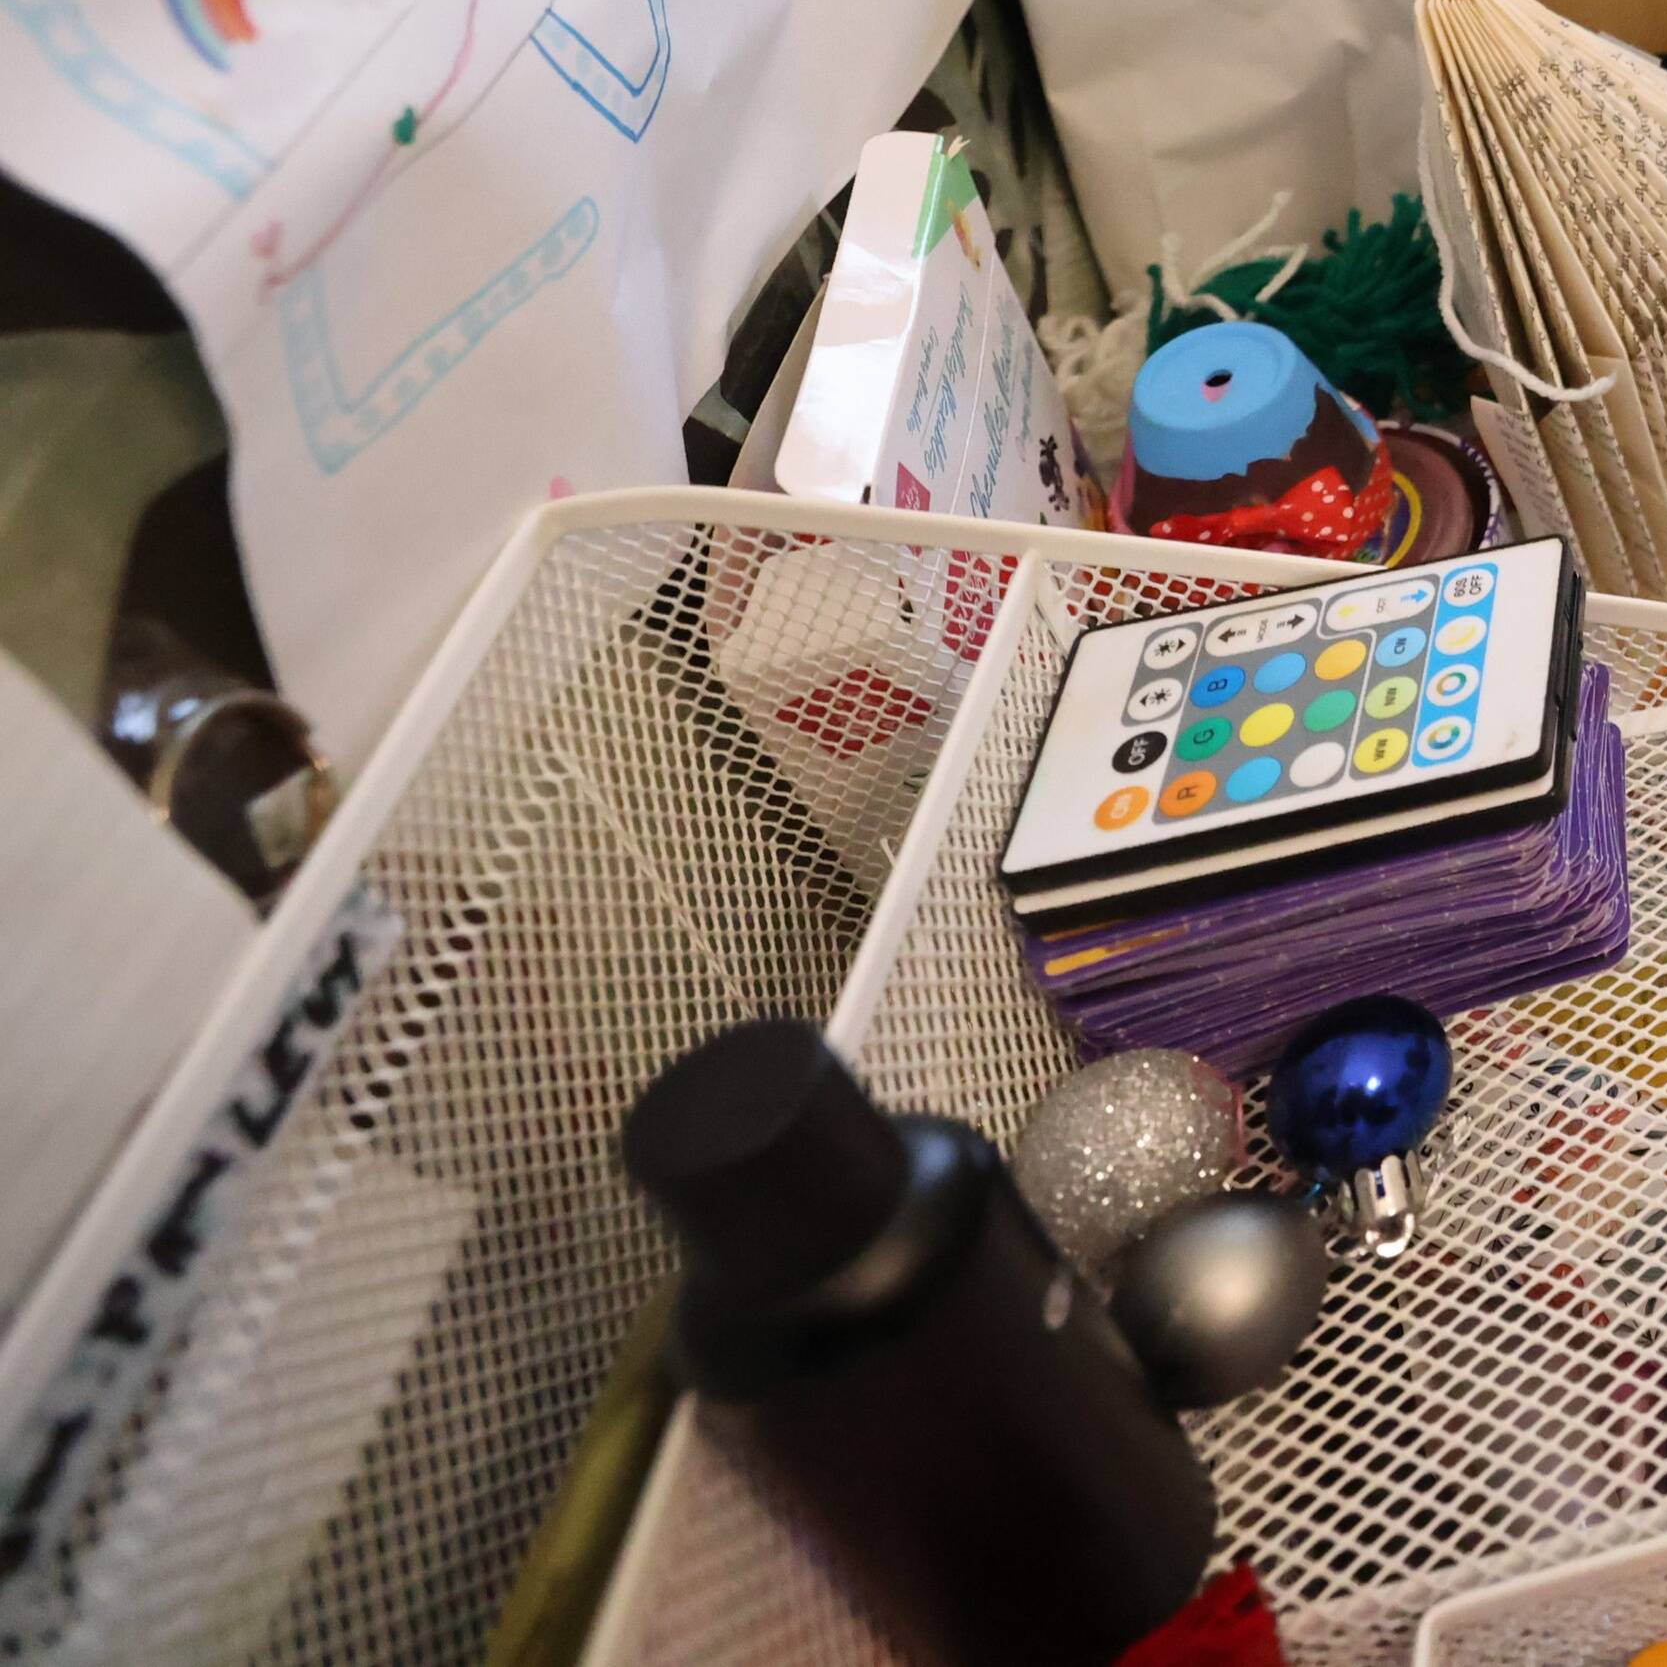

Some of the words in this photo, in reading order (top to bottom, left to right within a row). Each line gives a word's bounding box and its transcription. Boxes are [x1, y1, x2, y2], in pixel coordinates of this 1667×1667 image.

[1469, 573, 1484, 595] OFF
[1208, 677, 1228, 693] B
[1193, 727, 1214, 746] G
[1127, 737, 1149, 767] OFF
[1177, 785, 1199, 802] R
